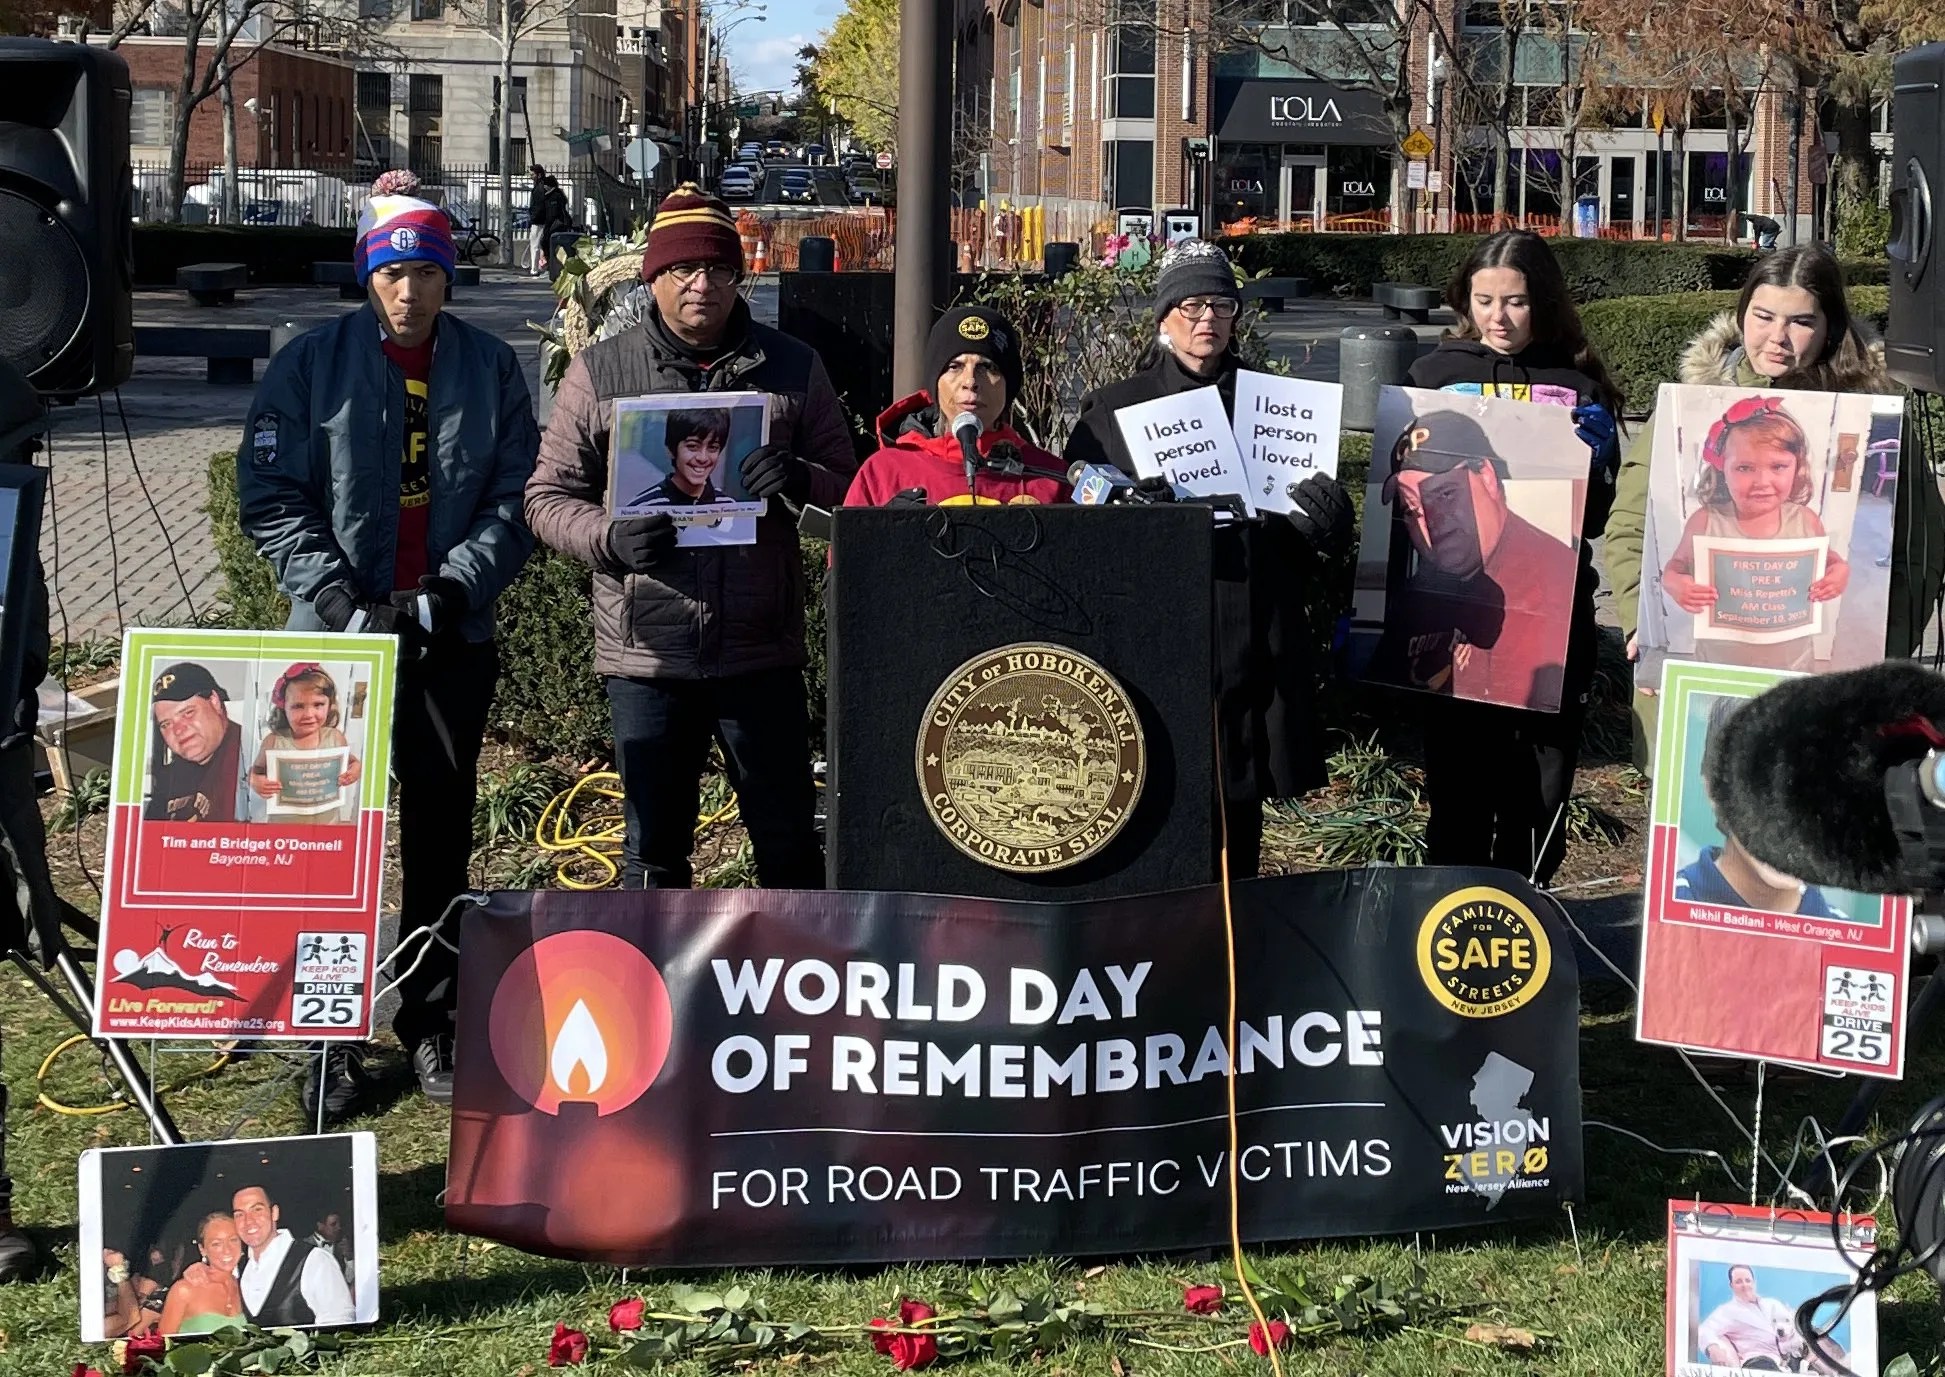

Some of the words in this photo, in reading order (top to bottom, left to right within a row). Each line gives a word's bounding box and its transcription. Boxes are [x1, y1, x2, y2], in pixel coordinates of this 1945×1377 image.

[1704, 187, 1728, 200] LOL
[1256, 395, 1261, 412] I
[1264, 396, 1297, 418] lost
[1300, 406, 1313, 420] a
[1144, 425, 1153, 441] I
[1153, 418, 1188, 439] lost
[1190, 418, 1203, 430] a
[1254, 423, 1318, 444] person
[1154, 438, 1217, 467] person
[1252, 443, 1257, 460] I
[1262, 445, 1319, 469] loved.
[1172, 459, 1228, 484] loved.
[1733, 561, 1760, 571] FIRST
[1763, 561, 1784, 571] DAY
[1786, 560, 1799, 570] OF
[1751, 576, 1783, 586] PRE-K
[1730, 587, 1753, 598] Miss
[1741, 601, 1760, 612] AM
[1717, 610, 1770, 625] September
[933, 673, 977, 727] CITY
[982, 664, 1002, 681] OF
[1006, 652, 1115, 712] HOBOKEN,
[1111, 709, 1135, 748] N.J.
[933, 792, 1063, 867] CORPORATE
[1069, 805, 1123, 856] SEAL
[161, 836, 187, 848] Tim
[190, 837, 216, 849] and
[220, 838, 271, 852] Bridget
[274, 838, 343, 851] O'Donnell
[209, 853, 270, 867] Bayonne,
[274, 853, 294, 865] NJ
[1442, 905, 1524, 935] FAMILIES
[1689, 907, 1721, 921] Nikhil
[1723, 912, 1765, 929] Badiani
[1774, 918, 1800, 934] West
[1803, 922, 1843, 940] Orange,
[1846, 928, 1863, 942] NJ
[183, 929, 218, 950] Run
[220, 932, 239, 950] to
[200, 955, 280, 974] Remember
[1436, 937, 1532, 972] SAFE
[301, 965, 330, 974] KEEP
[332, 965, 357, 974] KIDS
[311, 973, 342, 981] ALIVE
[303, 983, 355, 995] DRIVE
[711, 958, 987, 1023] WORLD
[1009, 961, 1153, 1024] DAY
[1447, 974, 1523, 1001] STREETS
[108, 998, 142, 1013] Live
[300, 997, 353, 1025] 25
[1451, 1000, 1477, 1015] NEW
[1480, 997, 1521, 1016] JERSEY
[1831, 999, 1859, 1008] KEEP
[1860, 1003, 1886, 1012] KIDS
[1841, 1008, 1871, 1018] ALIVE
[110, 1016, 285, 1032] www.KeepKidsAliveDrive25.org
[1833, 1015, 1883, 1033] DRIVE
[711, 1034, 810, 1094] OF
[832, 1010, 1384, 1098] REMEMBRANCE
[1830, 1030, 1883, 1061] 25
[1440, 1117, 1550, 1149] VISION
[712, 1167, 810, 1210] FOR
[828, 1165, 962, 1203] ROAD
[979, 1159, 1180, 1202] TRAFFIC
[1196, 1139, 1393, 1188] VCTIMS
[1445, 1184, 1470, 1194] New
[1474, 1181, 1507, 1192] Jersey
[1507, 1177, 1550, 1190] Alliance
